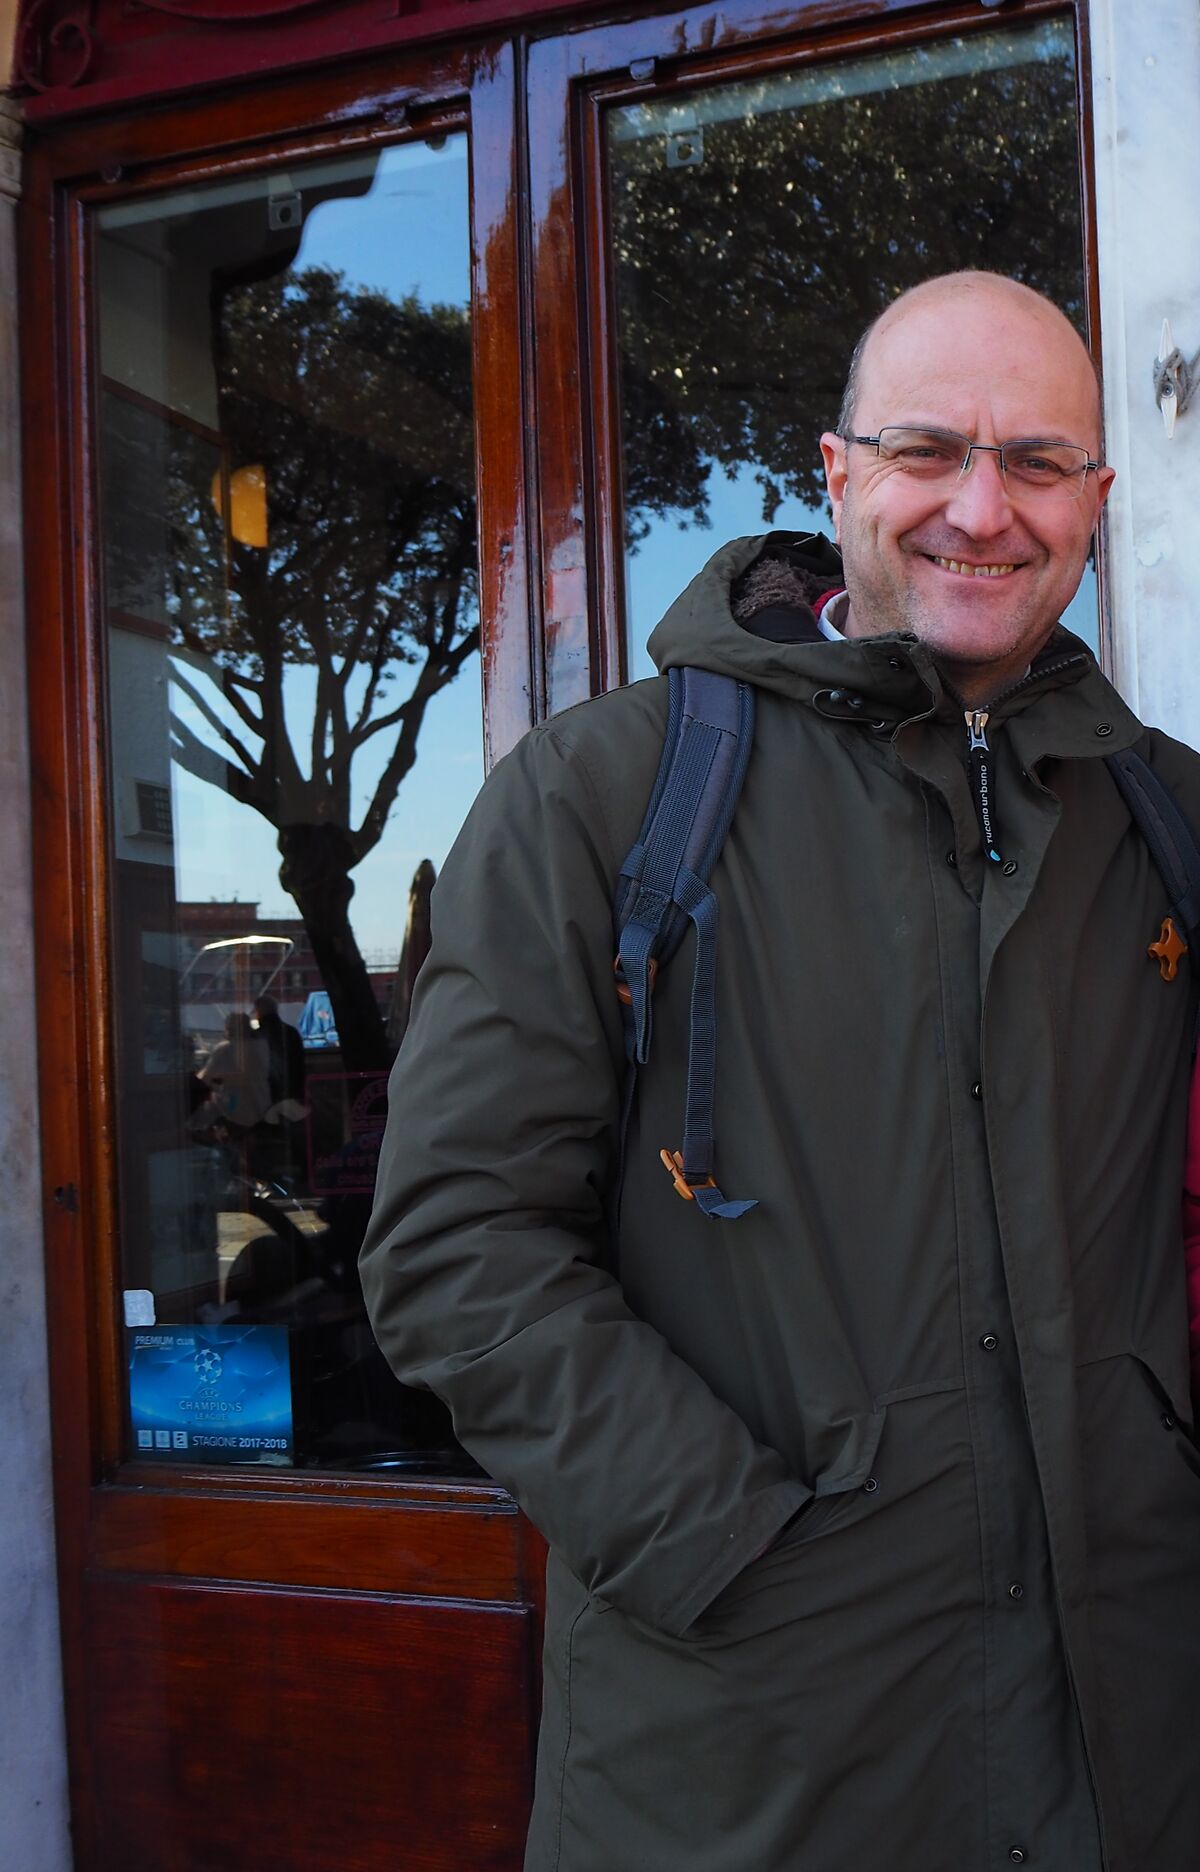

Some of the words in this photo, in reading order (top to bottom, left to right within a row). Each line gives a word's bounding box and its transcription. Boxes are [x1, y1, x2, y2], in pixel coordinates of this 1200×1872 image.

[979, 764, 988, 806] urbano
[135, 1335, 174, 1345] PREMIUM
[178, 1400, 242, 1412] CHAMPIONS
[192, 1435, 238, 1448] STAGIONE
[238, 1437, 287, 1449] 2017-2018
